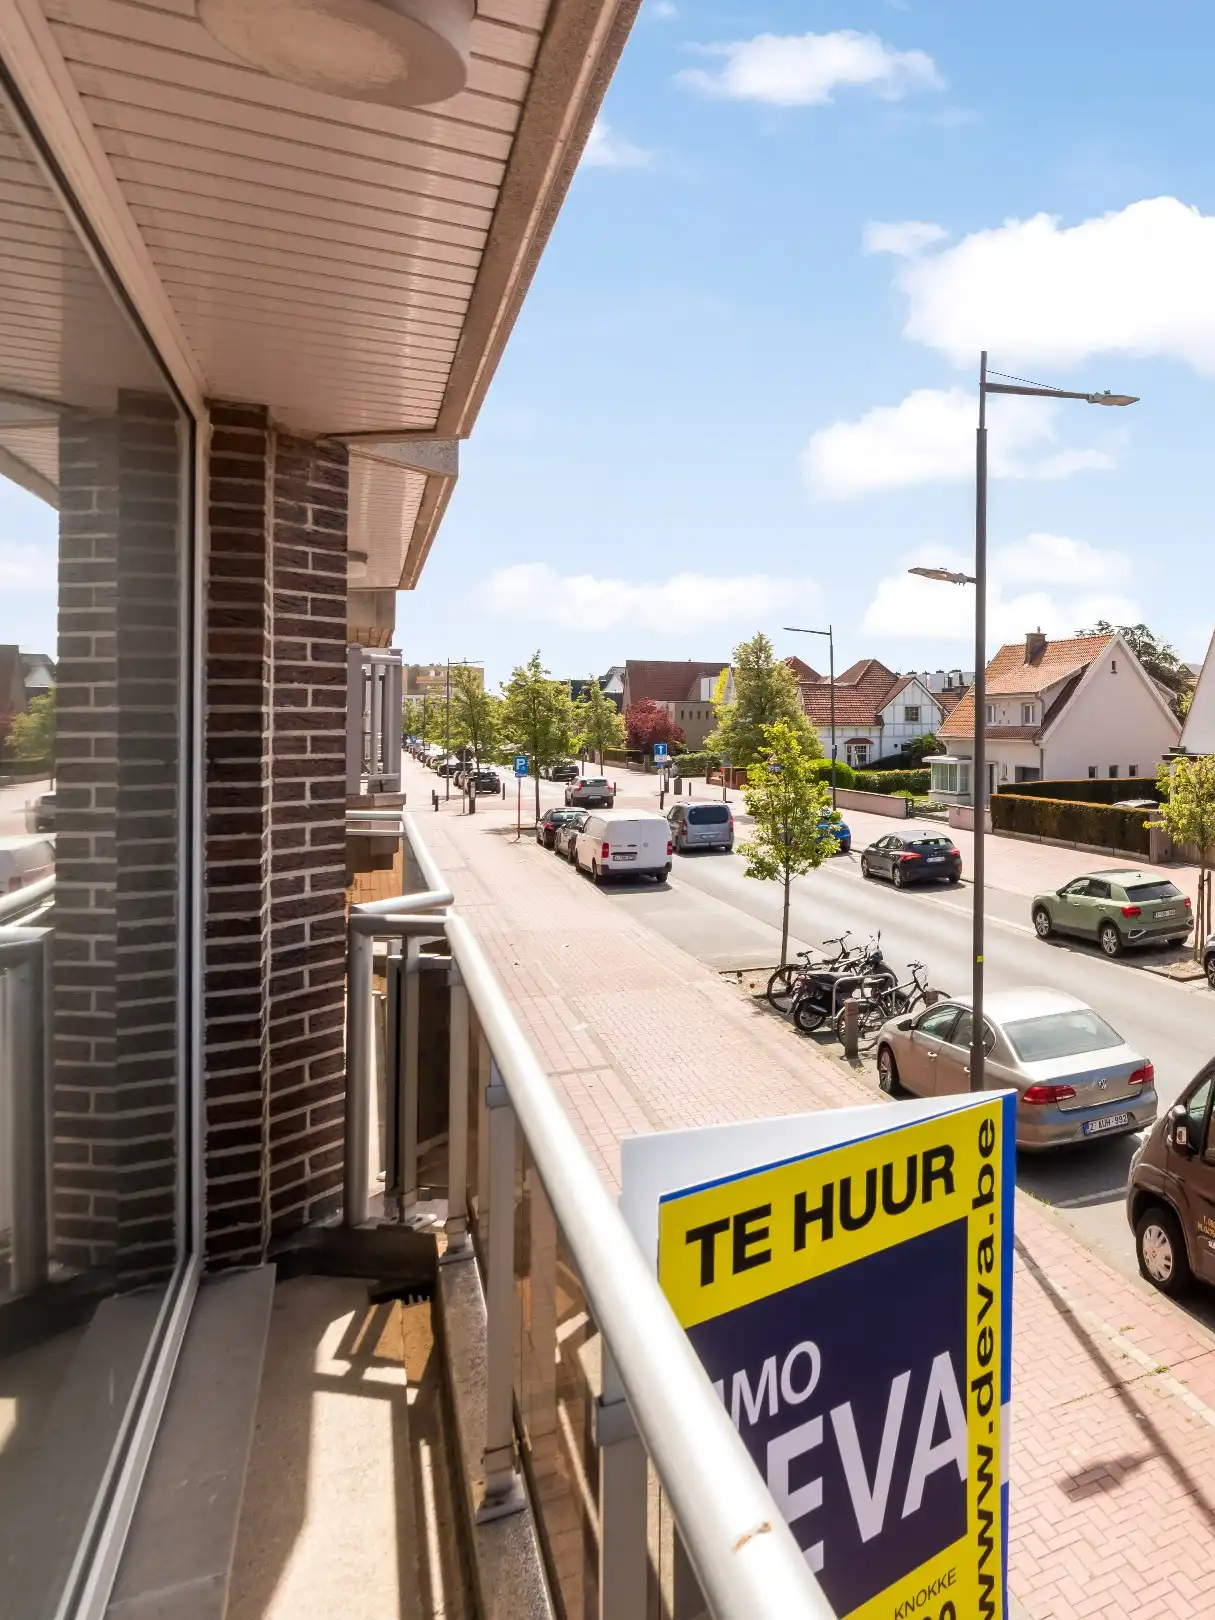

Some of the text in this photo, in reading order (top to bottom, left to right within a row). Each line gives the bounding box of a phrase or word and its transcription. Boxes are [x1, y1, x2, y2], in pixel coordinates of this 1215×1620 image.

[516, 758, 526, 770] P
[685, 1143, 957, 1288] TE HUUR
[692, 1340, 821, 1433] MO
[972, 1118, 996, 1620] www.deva.be
[894, 1566, 957, 1620] KNOKKE
